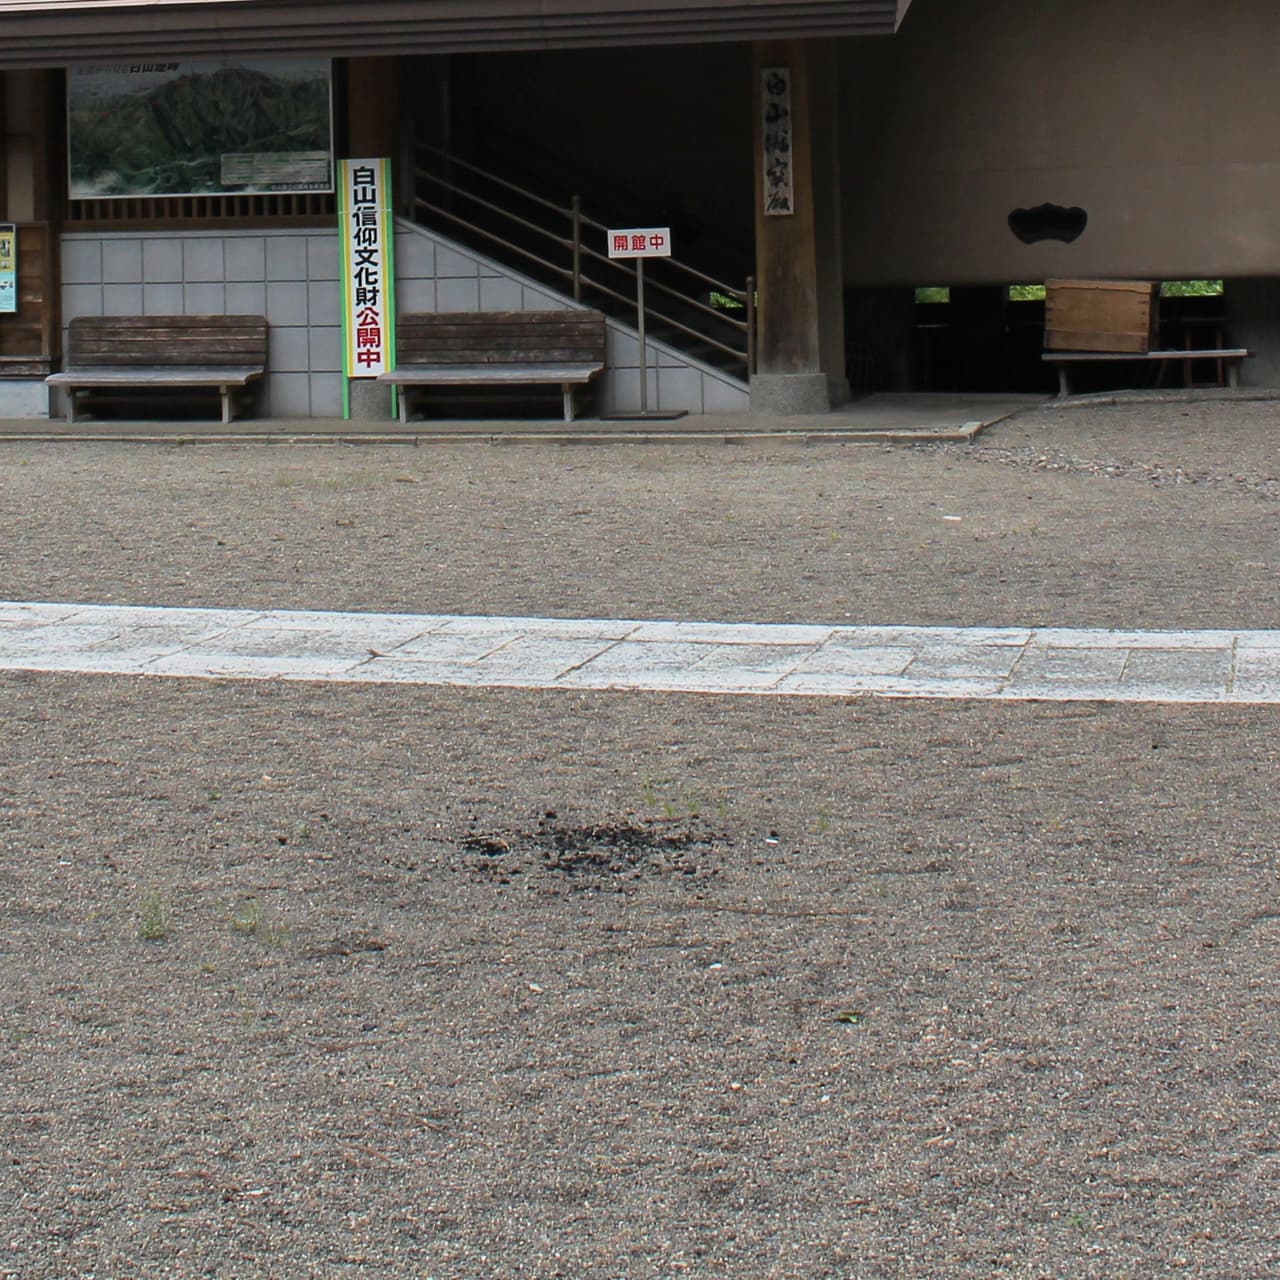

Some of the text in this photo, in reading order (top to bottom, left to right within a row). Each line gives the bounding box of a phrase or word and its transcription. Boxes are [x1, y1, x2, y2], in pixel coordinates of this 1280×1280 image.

[352, 166, 382, 368] 白山信仰文化財公開中
[613, 234, 664, 251] 開館中
